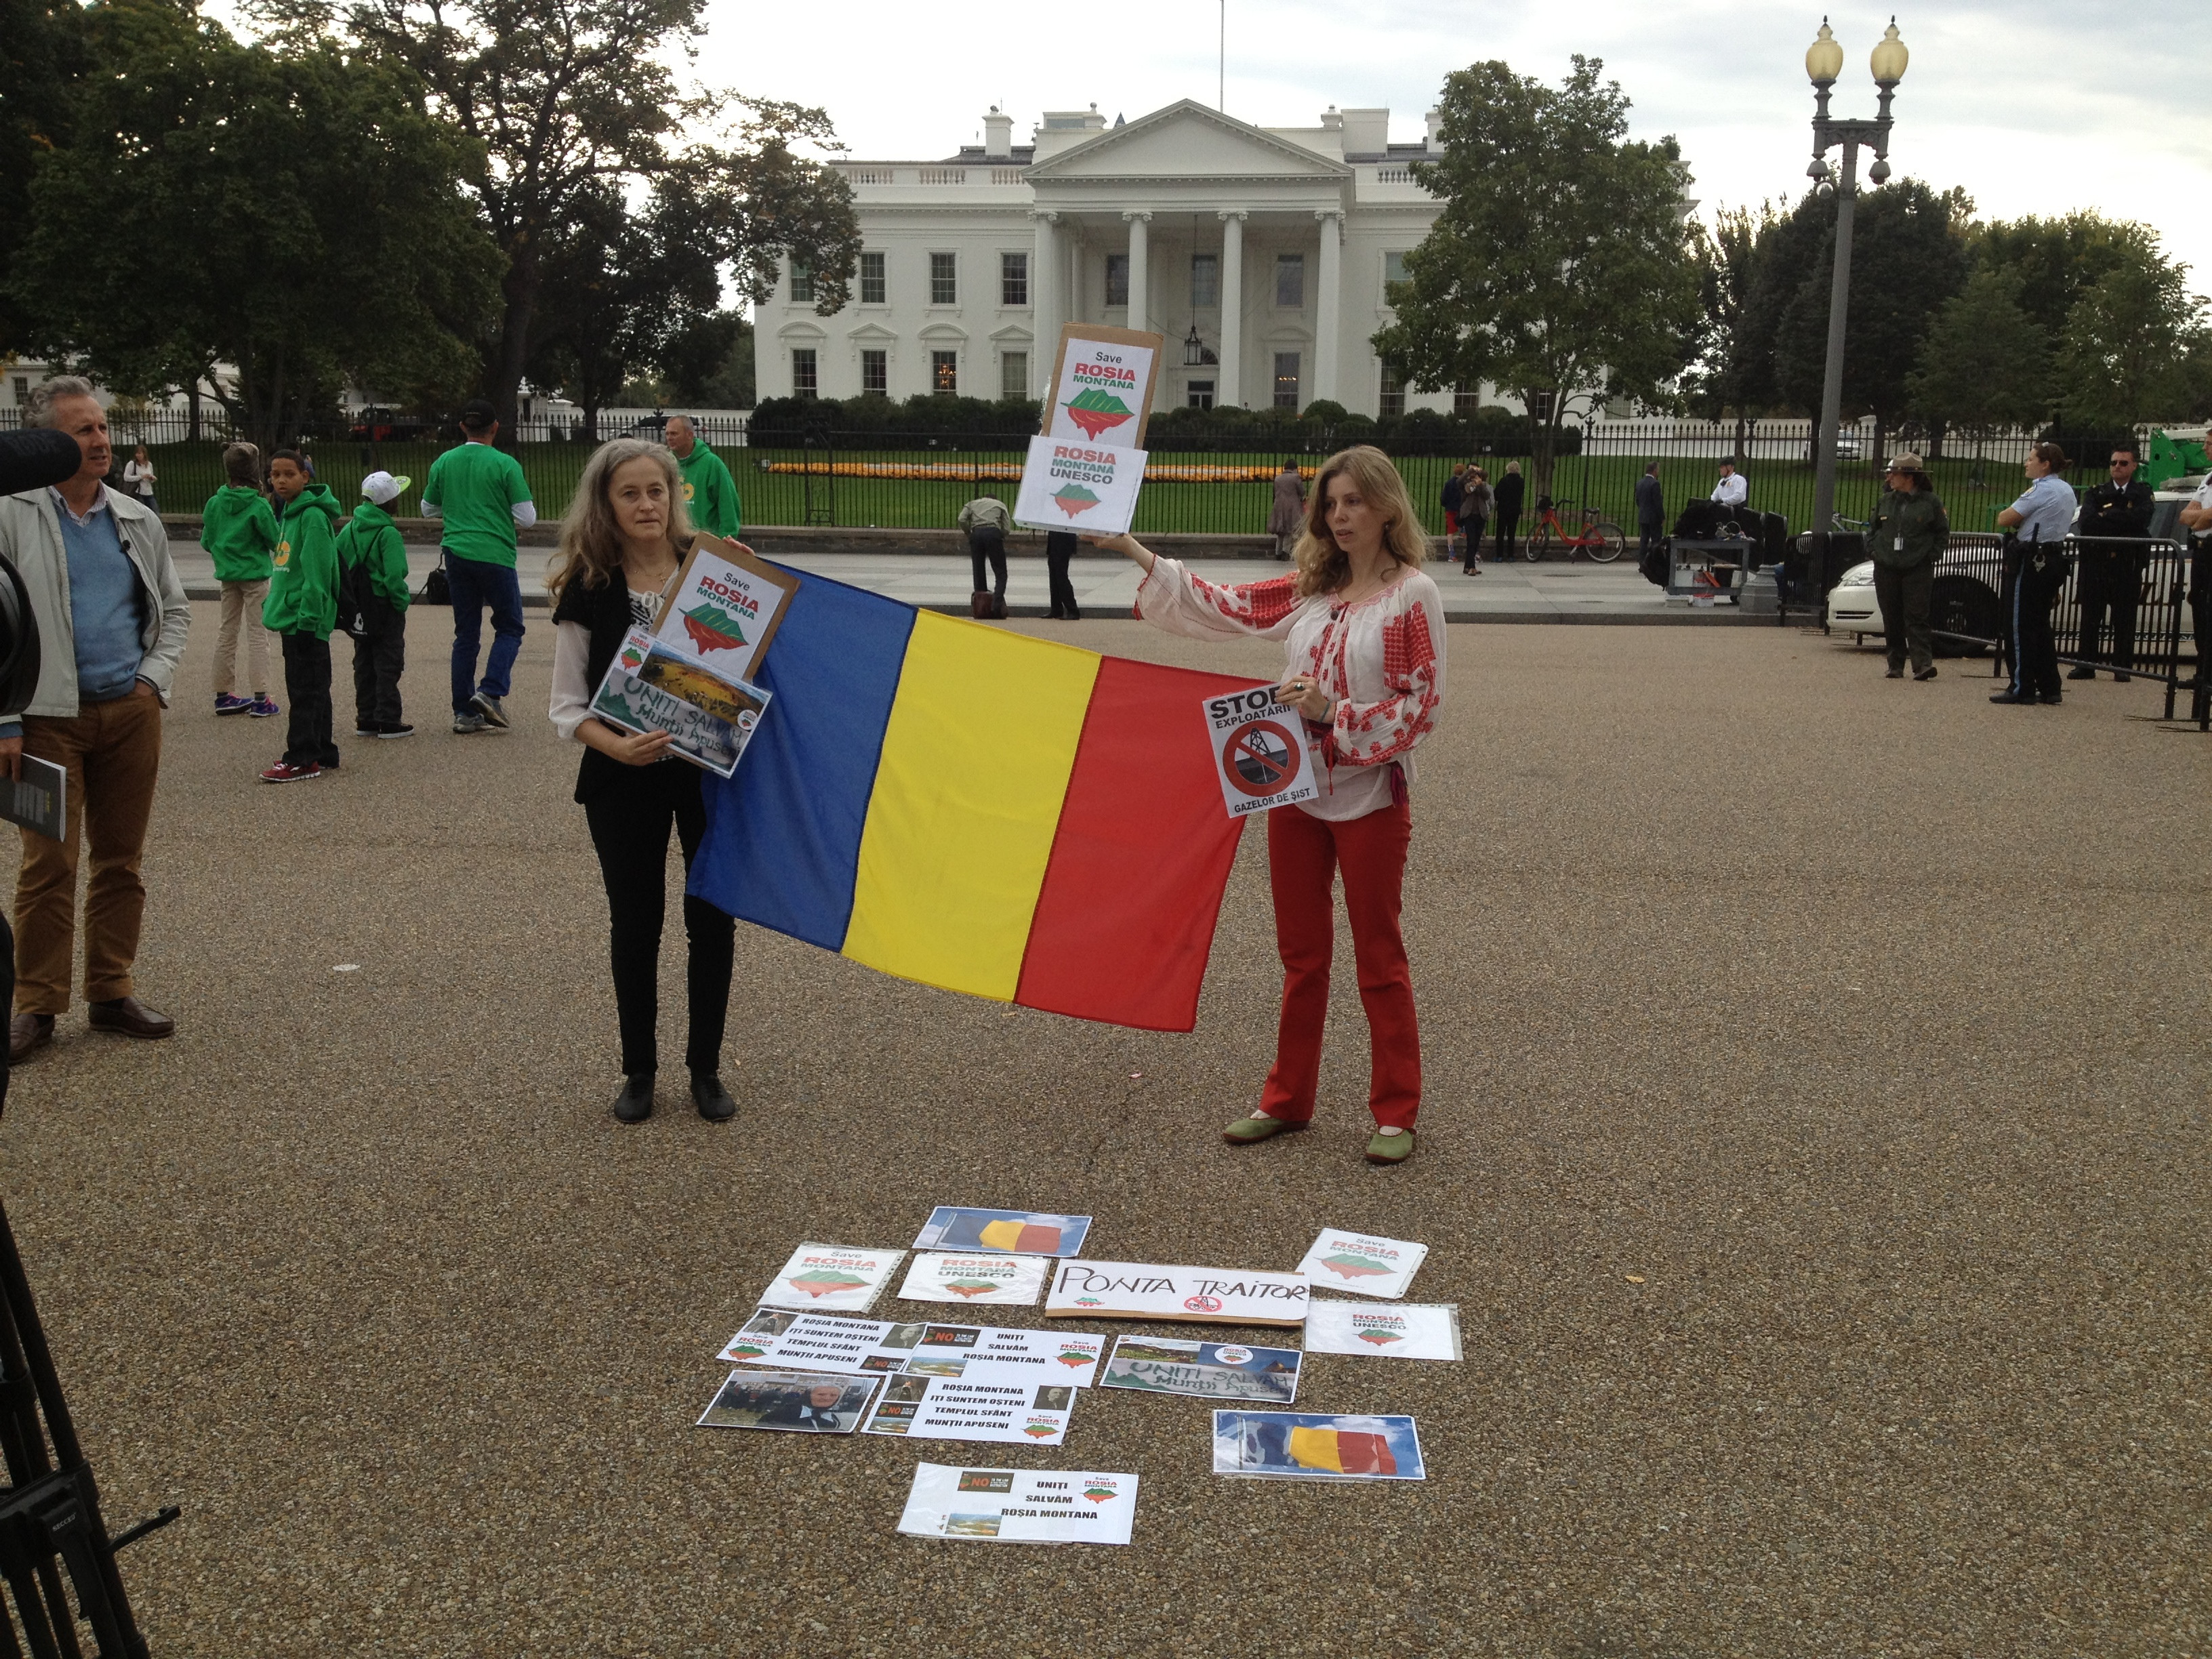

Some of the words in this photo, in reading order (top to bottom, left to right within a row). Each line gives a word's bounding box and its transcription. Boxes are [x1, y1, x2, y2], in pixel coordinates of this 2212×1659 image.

[1095, 352, 1122, 364] Save
[1074, 363, 1136, 382] ROSIA
[1073, 374, 1134, 390] MONTANA
[1054, 446, 1116, 465] ROSIA
[1052, 458, 1115, 474] MONTANA
[1050, 468, 1113, 485] UNESCO
[724, 572, 750, 591] Save
[699, 575, 759, 613] ROSIA
[696, 586, 755, 620] MONTANA
[630, 636, 649, 649] ROSIA
[1234, 796, 1275, 813] GAZELOR
[1277, 792, 1290, 803] DE
[1355, 1238, 1385, 1247] Save
[1330, 1246, 1398, 1261] MONTANA
[1332, 1240, 1399, 1257] ROSIA
[803, 1256, 876, 1267] ROSIA
[942, 1259, 1017, 1268] ROSIA
[800, 1263, 874, 1271] MONTANA
[1059, 1266, 1176, 1294] PONTA
[833, 1321, 880, 1331] MONTANA
[802, 1329, 844, 1338] SUNTEM
[935, 1332, 954, 1342] NO
[787, 1338, 828, 1348] TEMPLUL
[814, 1353, 858, 1363] APUSENI
[996, 1355, 1046, 1364] MONTANA
[975, 1386, 1023, 1395] MONTANA
[946, 1395, 988, 1405] SUNTEM
[888, 1406, 901, 1414] NO
[935, 1407, 979, 1416] TEMPLUL
[964, 1420, 1009, 1429] APUSENI
[971, 1477, 989, 1488] NO
[1025, 1494, 1073, 1504] SALVĂM
[1040, 1509, 1098, 1519] MONTANA
